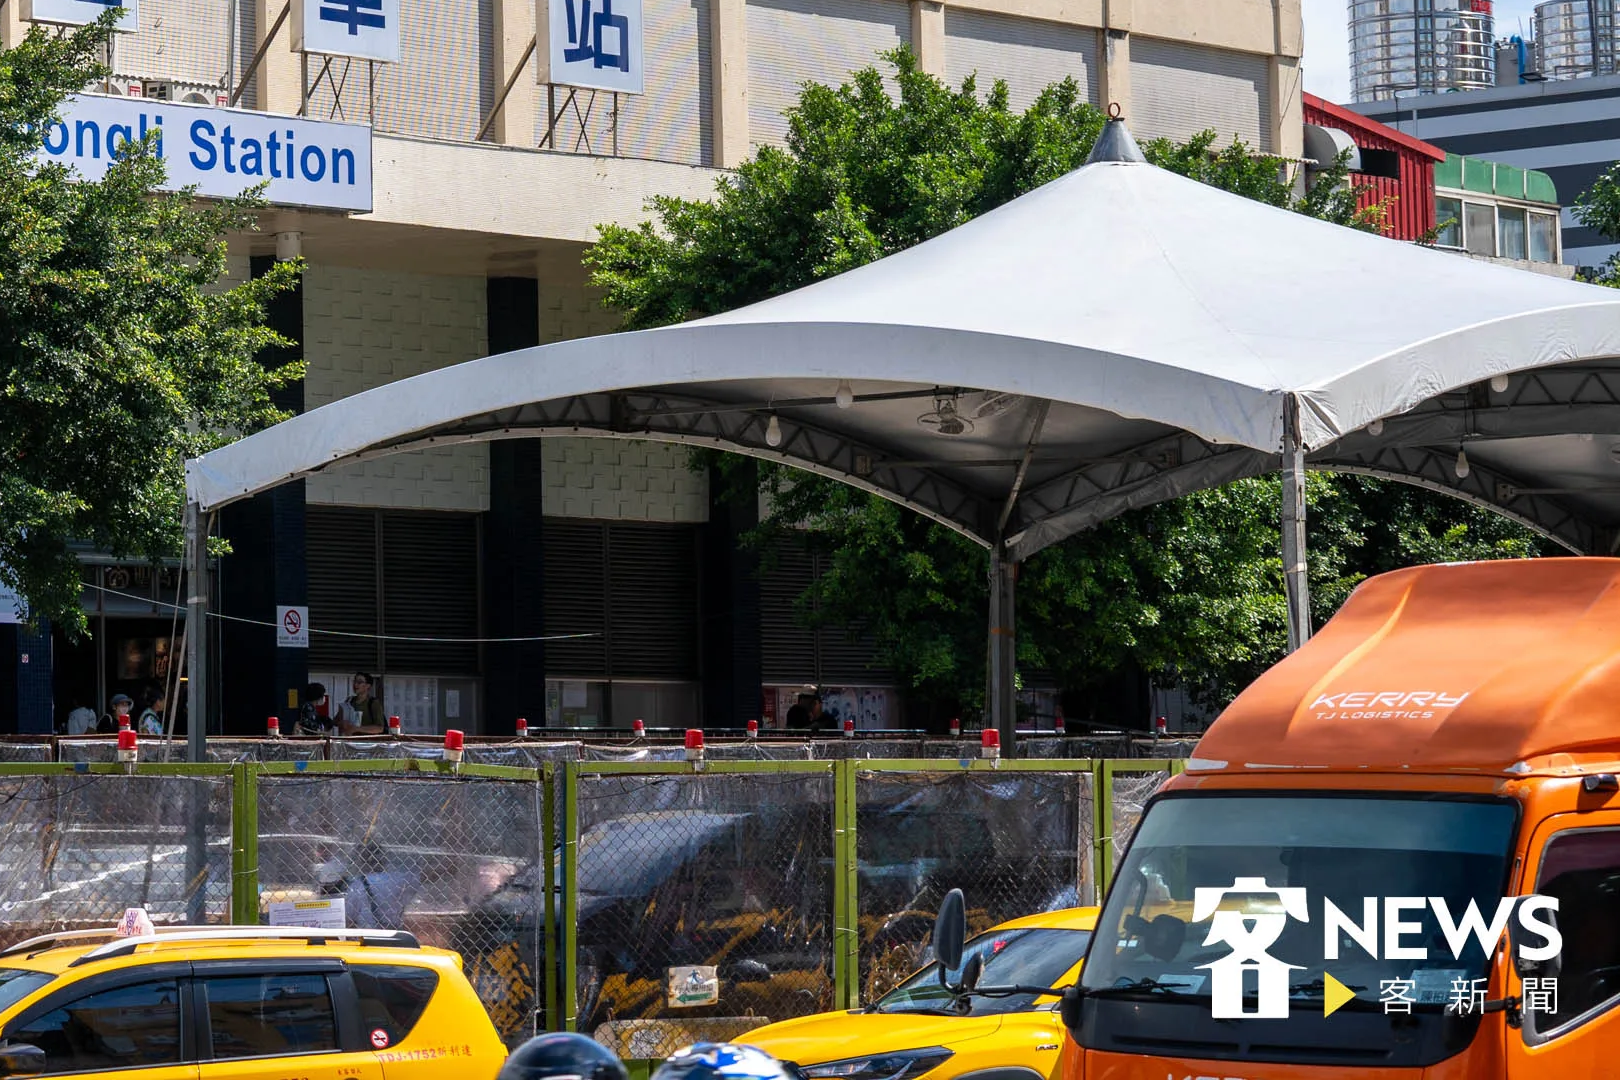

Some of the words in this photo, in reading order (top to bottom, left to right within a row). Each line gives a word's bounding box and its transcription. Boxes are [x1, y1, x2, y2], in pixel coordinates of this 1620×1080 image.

[11, 112, 164, 171] ongli
[189, 118, 357, 185] Station
[1308, 691, 1470, 710] KERRY
[1316, 711, 1337, 720] TJ
[1340, 711, 1434, 719] LOGISTICS
